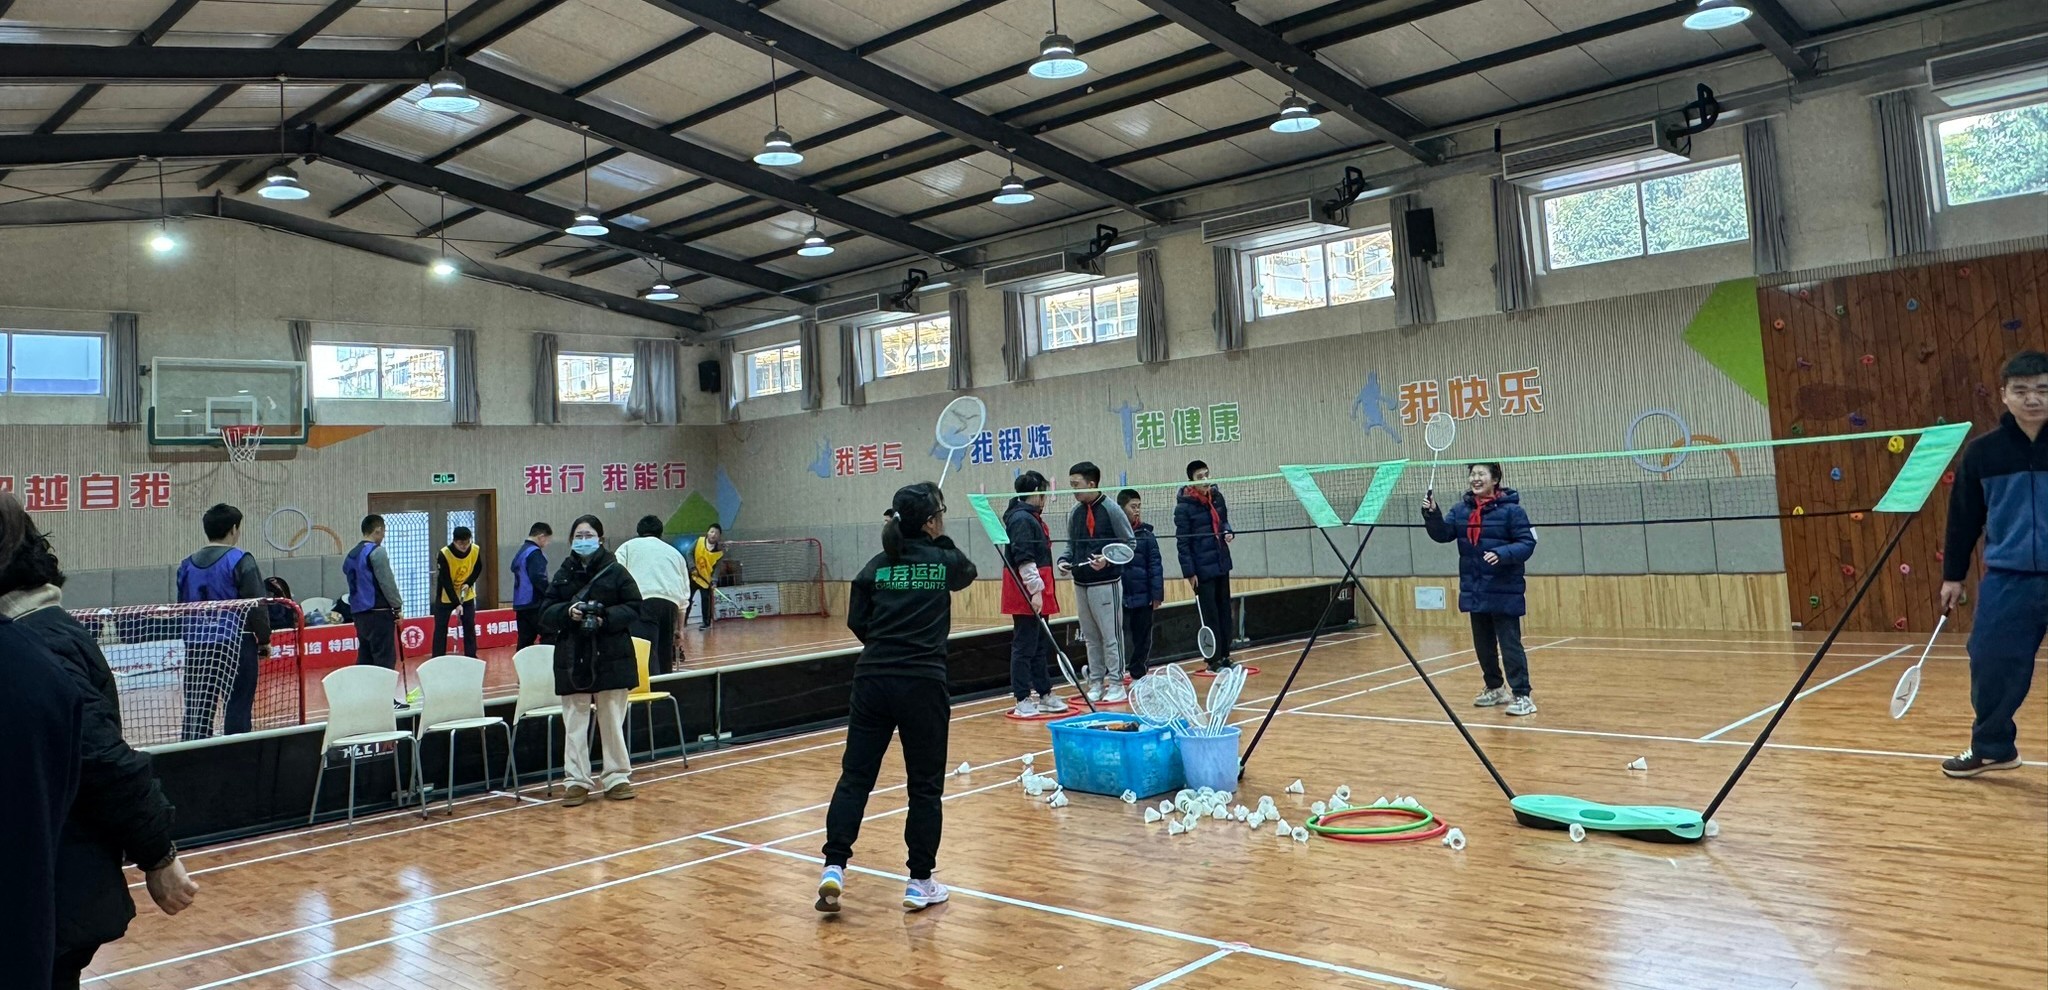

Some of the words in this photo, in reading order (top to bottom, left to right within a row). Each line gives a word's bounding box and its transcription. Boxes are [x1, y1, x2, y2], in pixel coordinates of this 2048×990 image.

[1399, 367, 1544, 425] 我快乐
[969, 424, 1054, 465] 我锻炼
[1135, 402, 1241, 450] 我健康
[524, 463, 586, 495] 我行
[602, 461, 687, 492] 我能行
[834, 442, 903, 477] 我参与
[0, 471, 171, 513] 越自我
[911, 581, 946, 590] SPORTS
